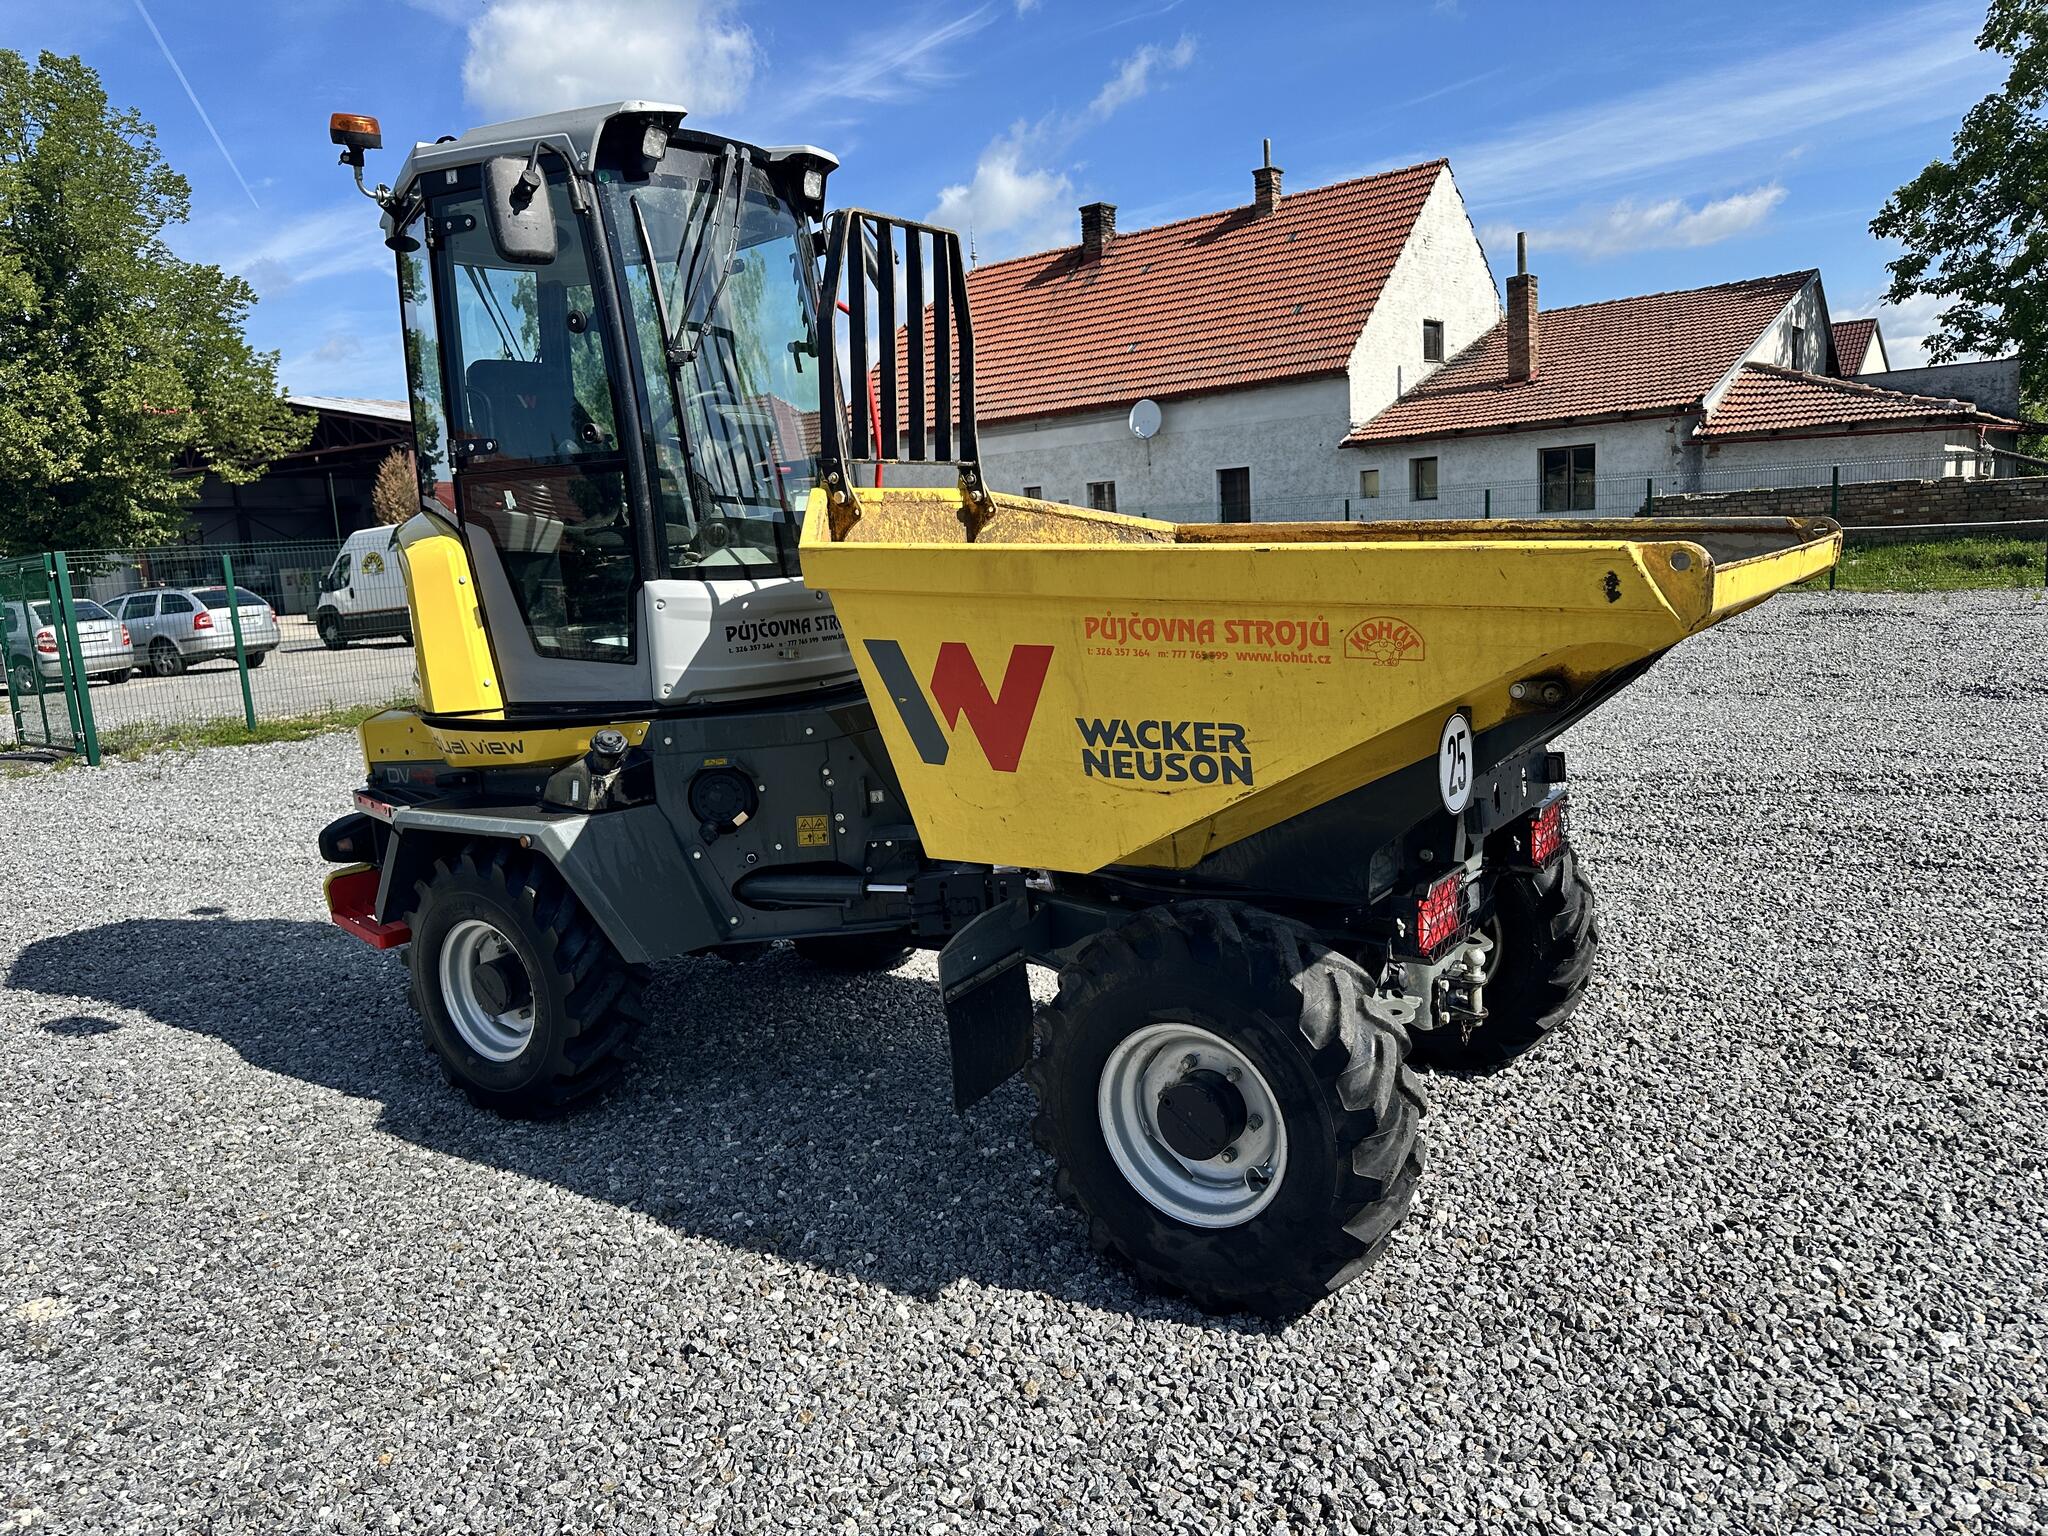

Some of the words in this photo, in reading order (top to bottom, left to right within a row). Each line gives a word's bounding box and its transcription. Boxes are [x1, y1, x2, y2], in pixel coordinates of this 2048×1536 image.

[725, 618, 811, 642] PŮJČOVNA
[1084, 611, 1215, 645] PŮJČOVNA
[1224, 615, 1330, 650] STROJŮ
[1096, 647, 1112, 656] 326
[1115, 648, 1130, 656] 357
[1133, 649, 1150, 657] 364
[1172, 650, 1187, 659] 777
[1236, 651, 1331, 665] www.kohut.cz
[471, 739, 525, 755] view
[1075, 717, 1252, 755] WACKER
[1082, 748, 1254, 786] NEUSON
[1447, 729, 1467, 798] 25
